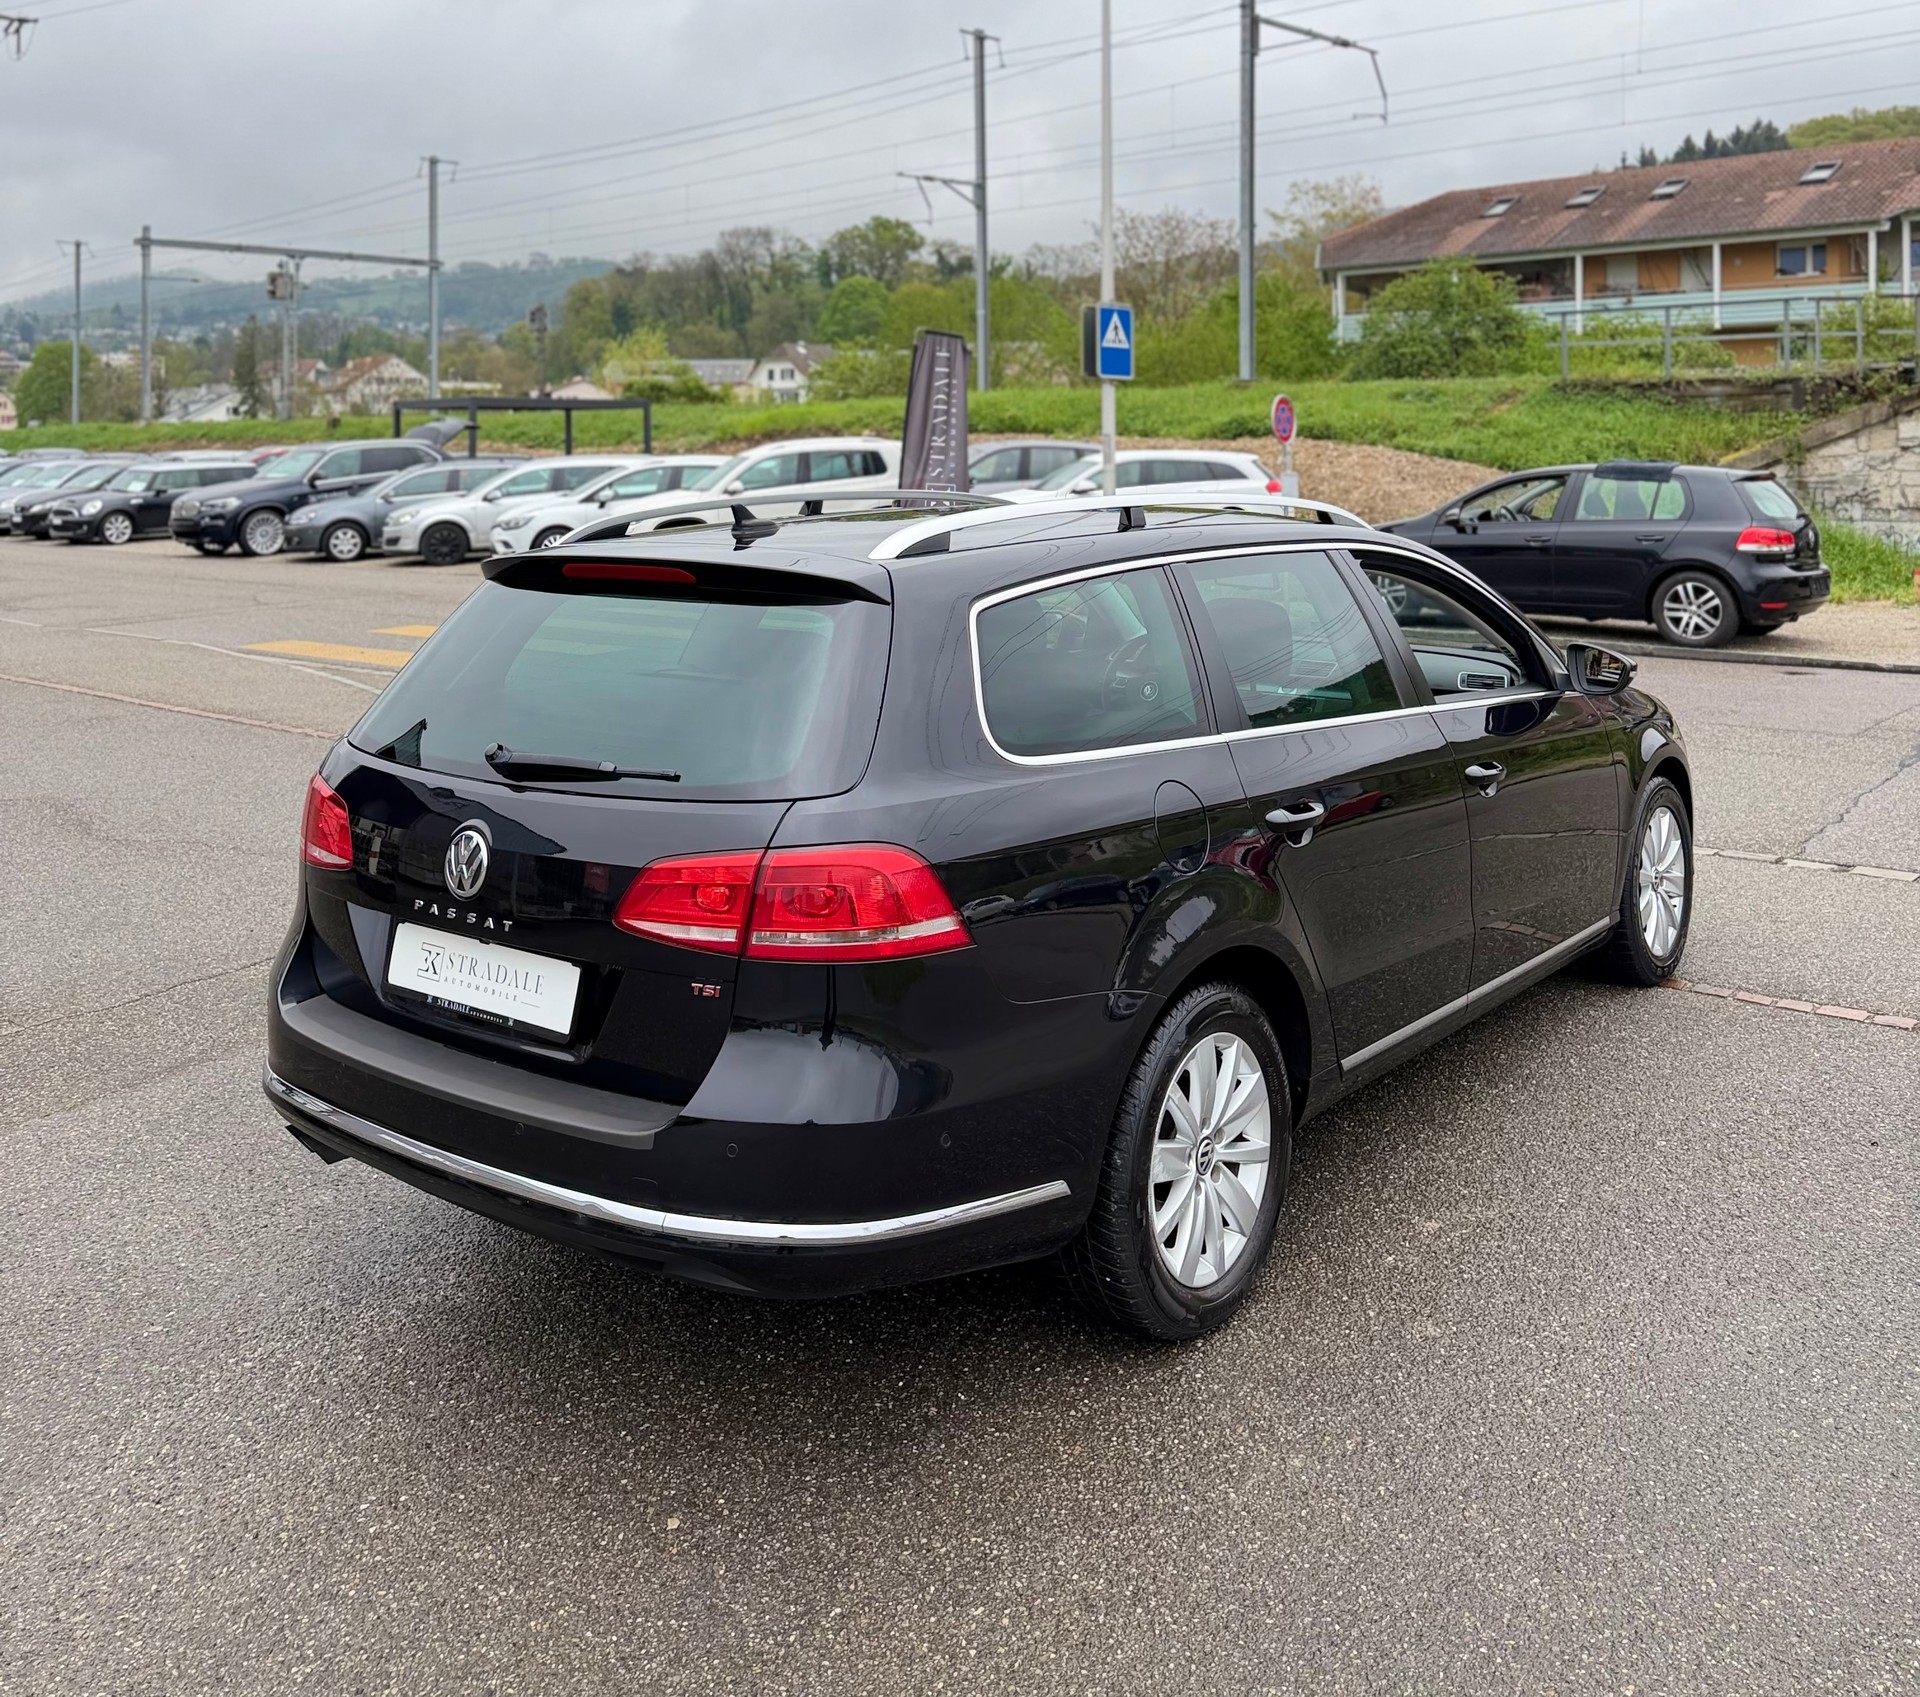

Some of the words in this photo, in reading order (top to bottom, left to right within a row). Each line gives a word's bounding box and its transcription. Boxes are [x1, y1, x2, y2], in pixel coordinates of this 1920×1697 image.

[413, 899, 513, 932] PASSAT
[445, 951, 545, 996] STRADALE
[444, 975, 518, 1002] AUTOMOBILE
[691, 982, 721, 998] TSI
[436, 998, 470, 1014] STRADALE
